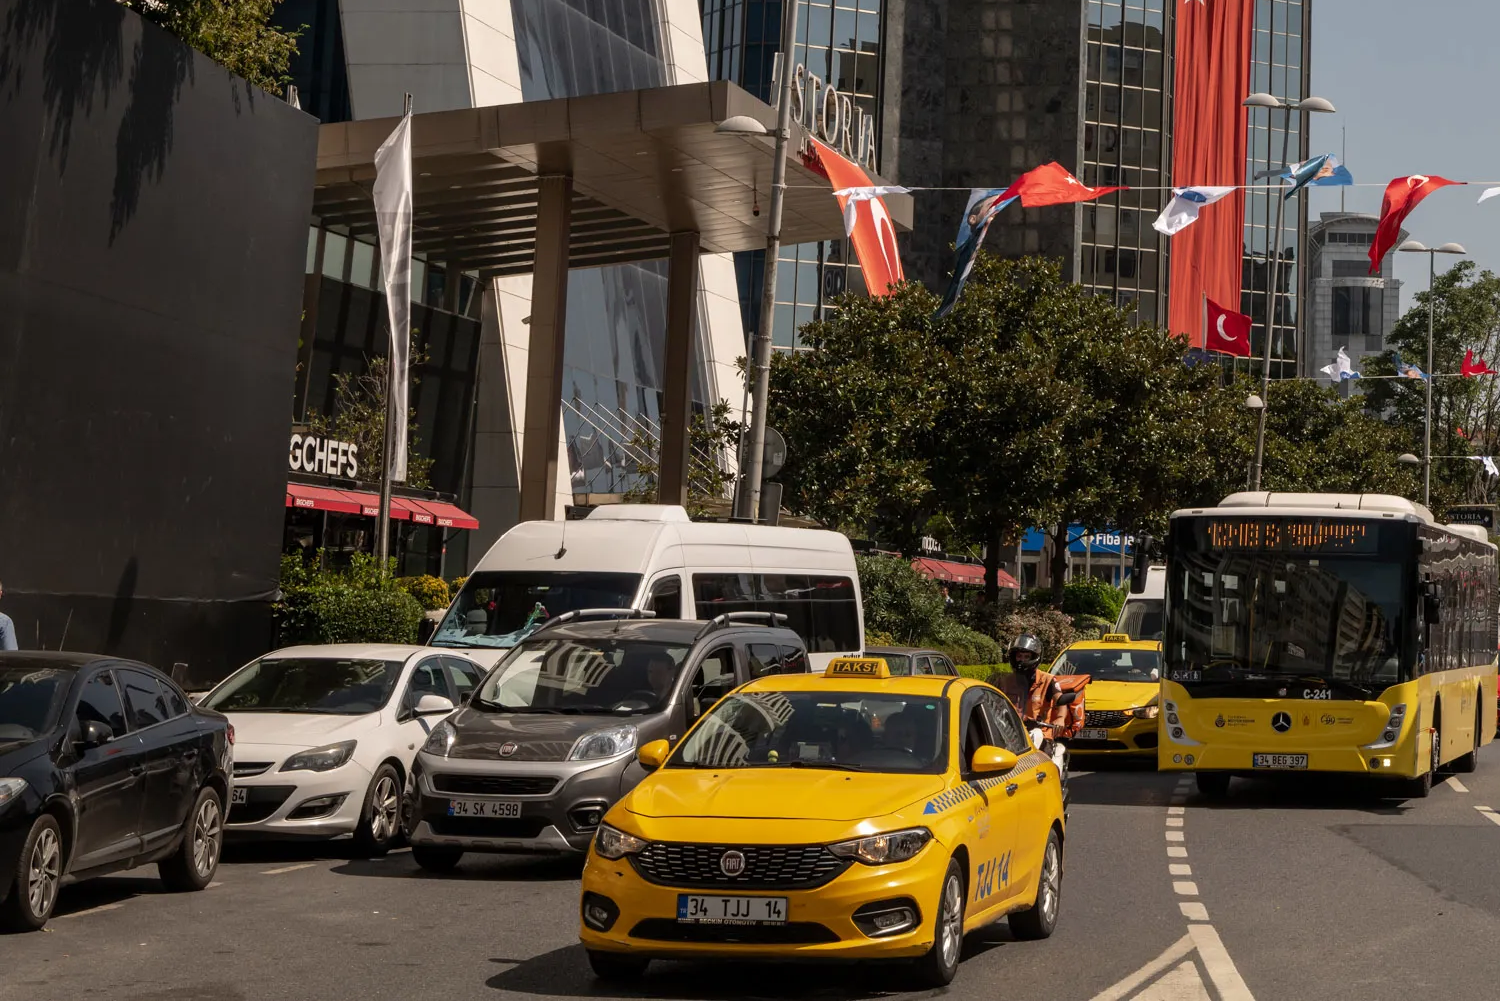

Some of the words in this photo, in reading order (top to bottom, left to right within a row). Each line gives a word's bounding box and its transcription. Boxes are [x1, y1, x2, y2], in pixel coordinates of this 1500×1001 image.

[1303, 689, 1333, 700] C-241
[1259, 755, 1270, 766] 34
[1272, 755, 1288, 766] BEG
[1289, 755, 1305, 766] 397
[453, 800, 468, 815] 34
[472, 801, 486, 816] SK
[491, 801, 519, 817] 4598
[725, 858, 741, 870] FIAT
[998, 849, 1012, 891] 14
[689, 898, 709, 917] 34
[721, 899, 751, 918] TJJ
[765, 900, 782, 918] 14
